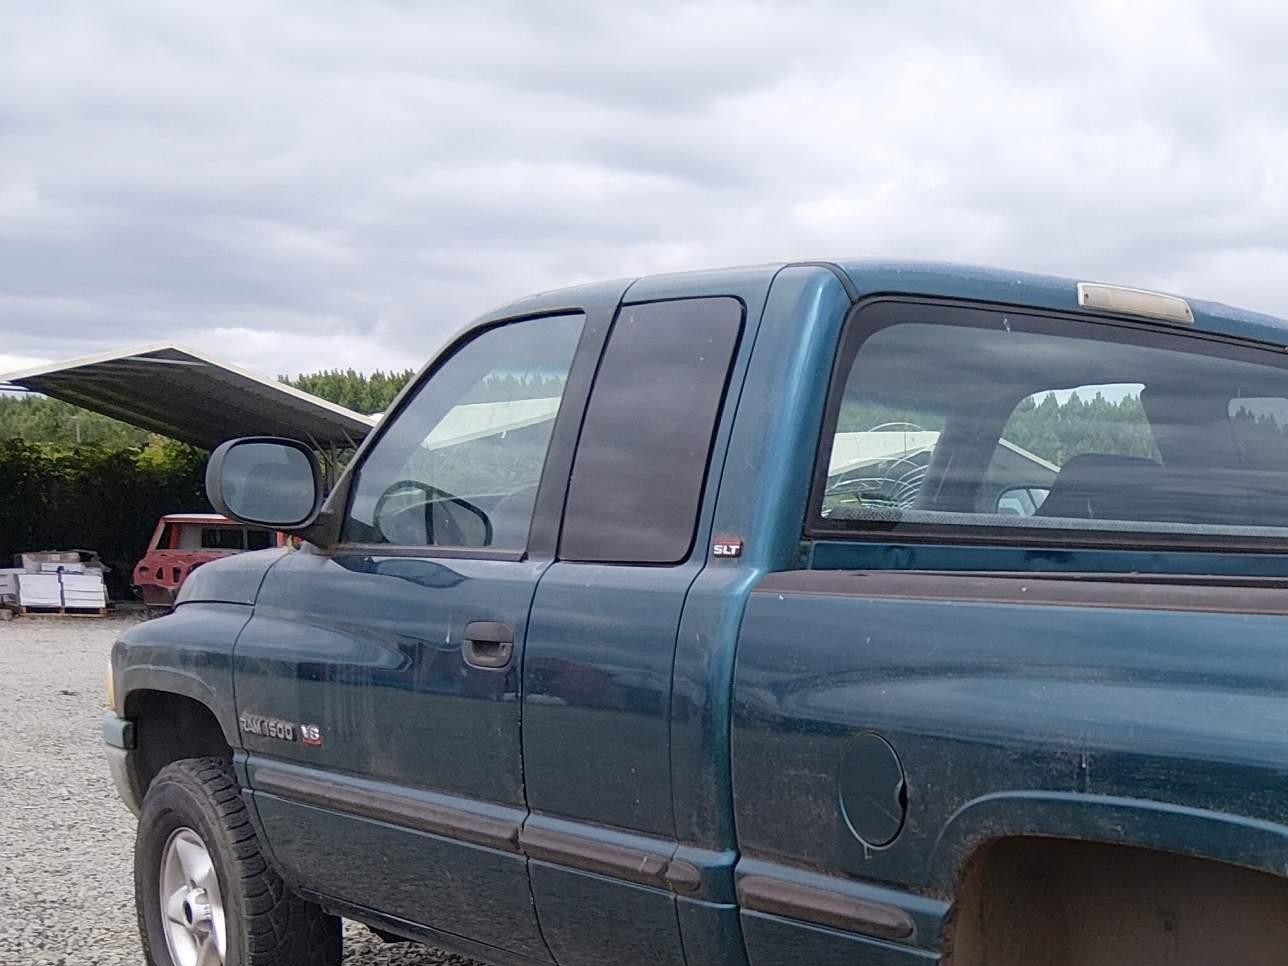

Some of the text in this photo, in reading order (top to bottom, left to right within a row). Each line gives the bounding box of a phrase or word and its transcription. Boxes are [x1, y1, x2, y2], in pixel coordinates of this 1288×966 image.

[713, 544, 740, 555] SLT
[263, 719, 293, 740] 1500
[301, 725, 320, 740] V8
